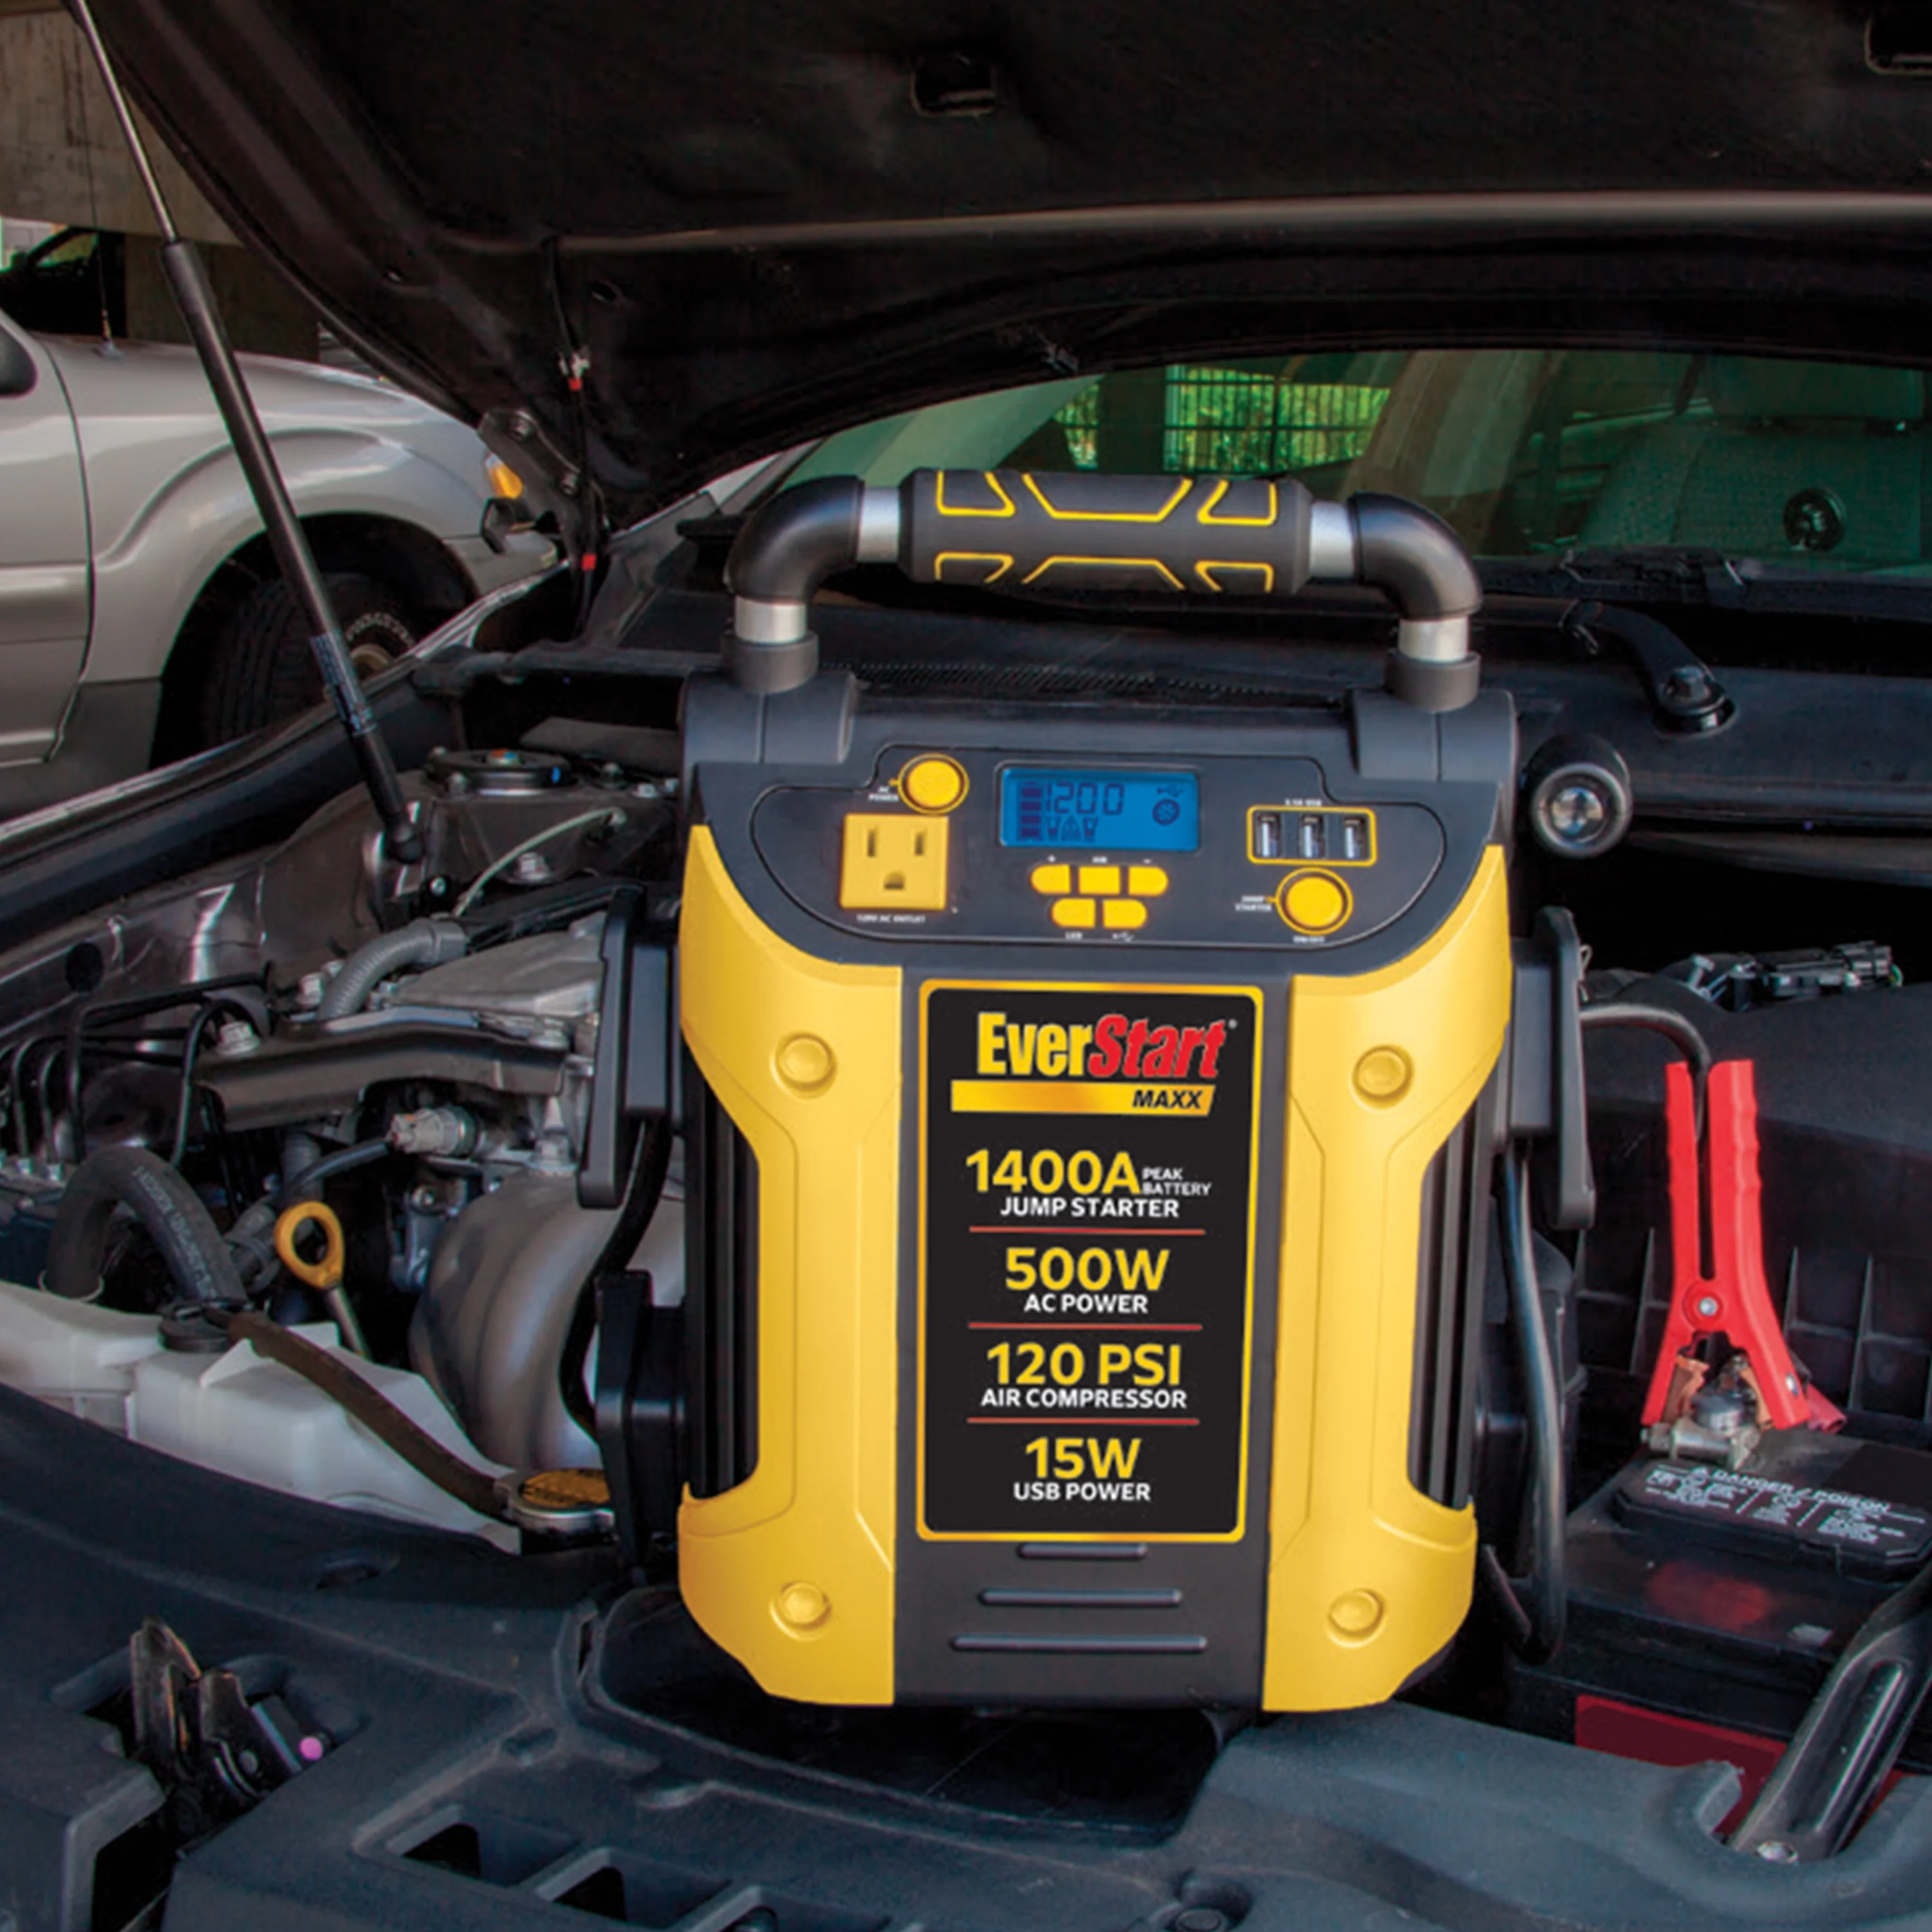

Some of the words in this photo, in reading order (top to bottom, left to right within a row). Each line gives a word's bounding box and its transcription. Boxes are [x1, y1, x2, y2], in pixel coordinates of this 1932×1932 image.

[1046, 782, 1124, 815] 1200
[976, 1012, 1226, 1078] EverStart
[1132, 1089, 1203, 1110] MAXX
[966, 1149, 1141, 1195] 1400A
[1142, 1168, 1183, 1181] PEAK
[1142, 1182, 1212, 1196] BATTERY
[1000, 1197, 1066, 1217] JUMP
[1070, 1198, 1179, 1218] STARTER
[1005, 1247, 1170, 1291] 500W
[1024, 1294, 1057, 1312] AC
[1061, 1294, 1148, 1313] POWER
[987, 1342, 1084, 1385] 120
[1098, 1344, 1181, 1386] PSI
[981, 1388, 1021, 1407] AIR
[1025, 1388, 1187, 1408] COMPRESSOR
[1025, 1437, 1141, 1479] 15W
[1013, 1482, 1061, 1501] USB
[1065, 1482, 1151, 1501] POWER
[1712, 1469, 1794, 1494] DANGER
